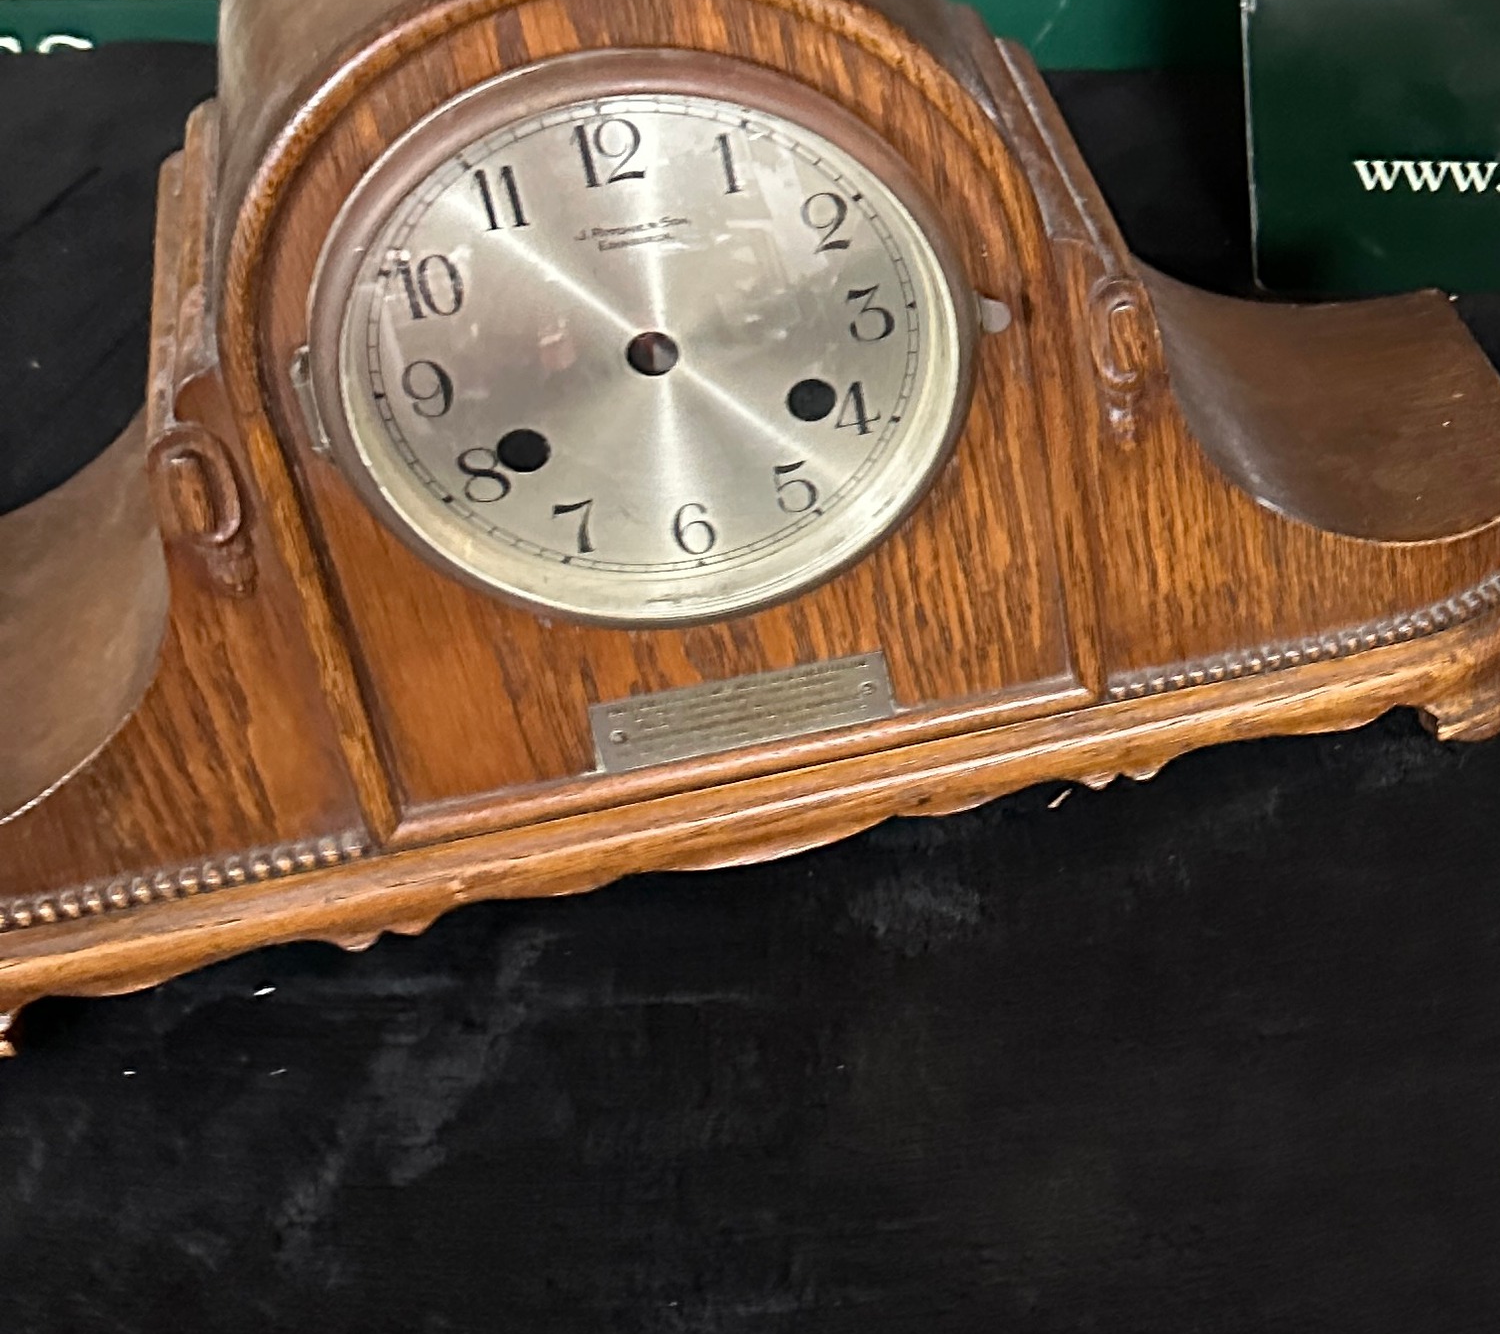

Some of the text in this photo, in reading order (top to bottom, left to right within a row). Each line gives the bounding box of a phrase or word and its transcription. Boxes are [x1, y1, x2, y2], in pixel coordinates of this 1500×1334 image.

[569, 117, 648, 188] 12
[711, 132, 743, 195] 1
[471, 164, 530, 232] 11
[801, 191, 853, 254] 2
[395, 253, 465, 321] 10
[843, 284, 895, 343] 3
[401, 360, 454, 418] 9
[833, 381, 882, 437] 4
[457, 447, 512, 503] 8
[772, 459, 818, 514] 5
[551, 498, 596, 554] 7
[672, 503, 717, 556] 6
